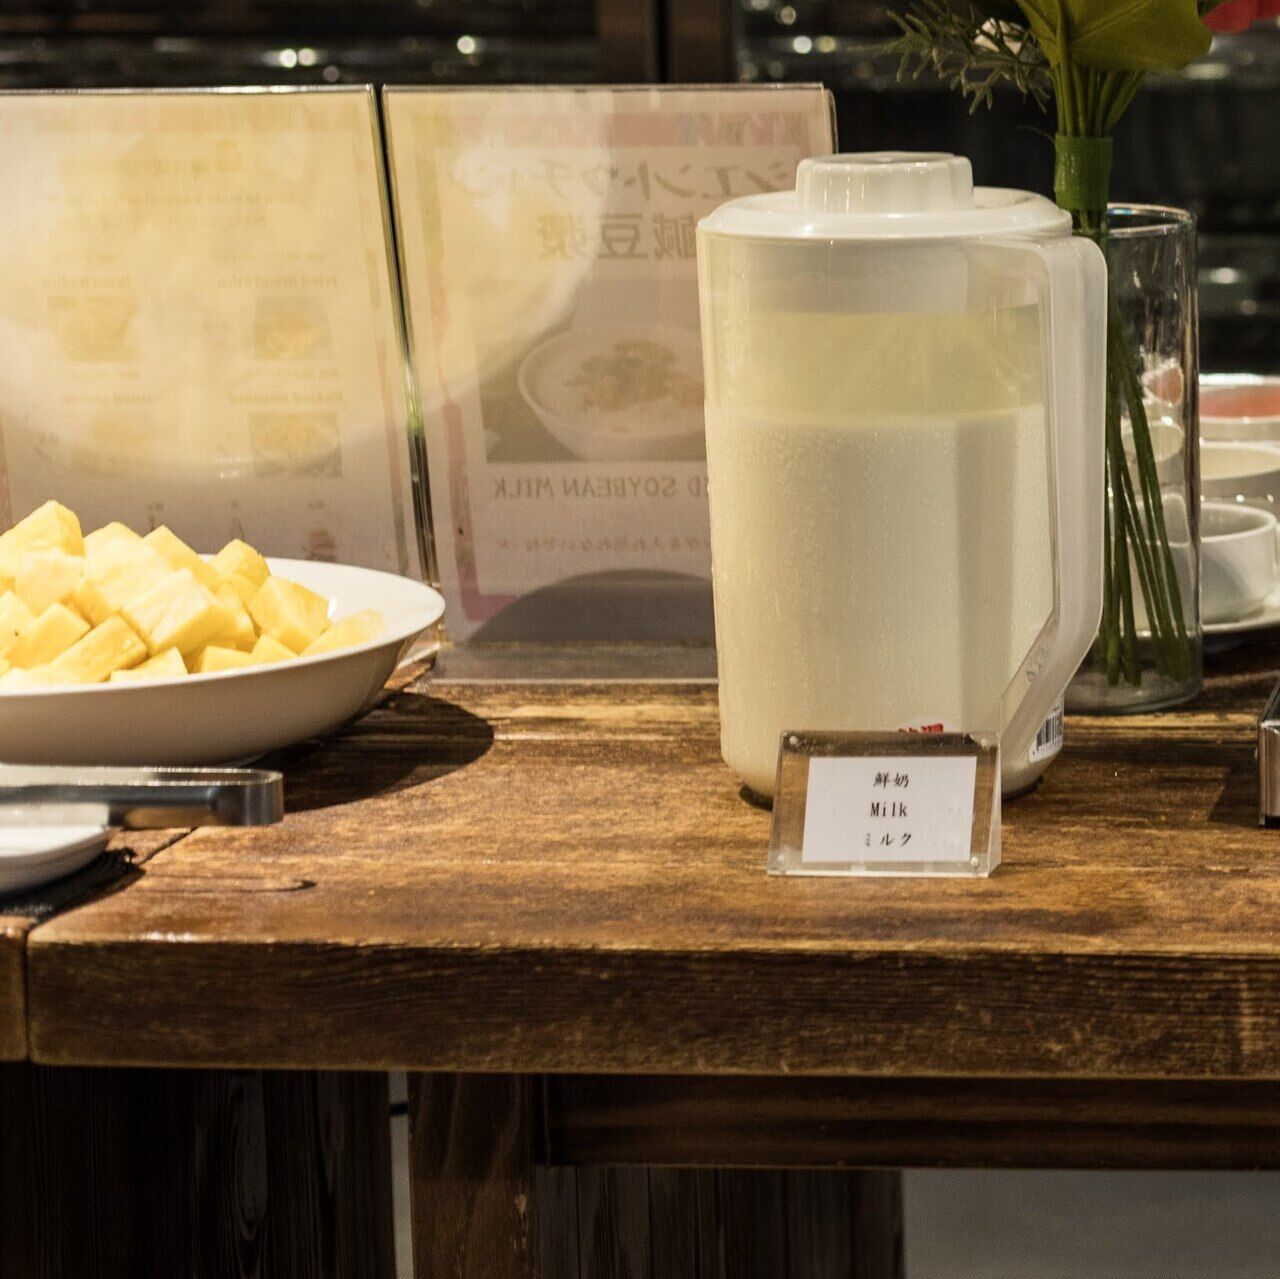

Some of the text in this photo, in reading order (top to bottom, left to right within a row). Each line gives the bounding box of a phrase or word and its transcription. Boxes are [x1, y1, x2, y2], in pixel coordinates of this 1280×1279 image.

[872, 771, 910, 789] 鮮奶
[870, 802, 908, 818] Milk
[865, 832, 912, 848] ミルク
